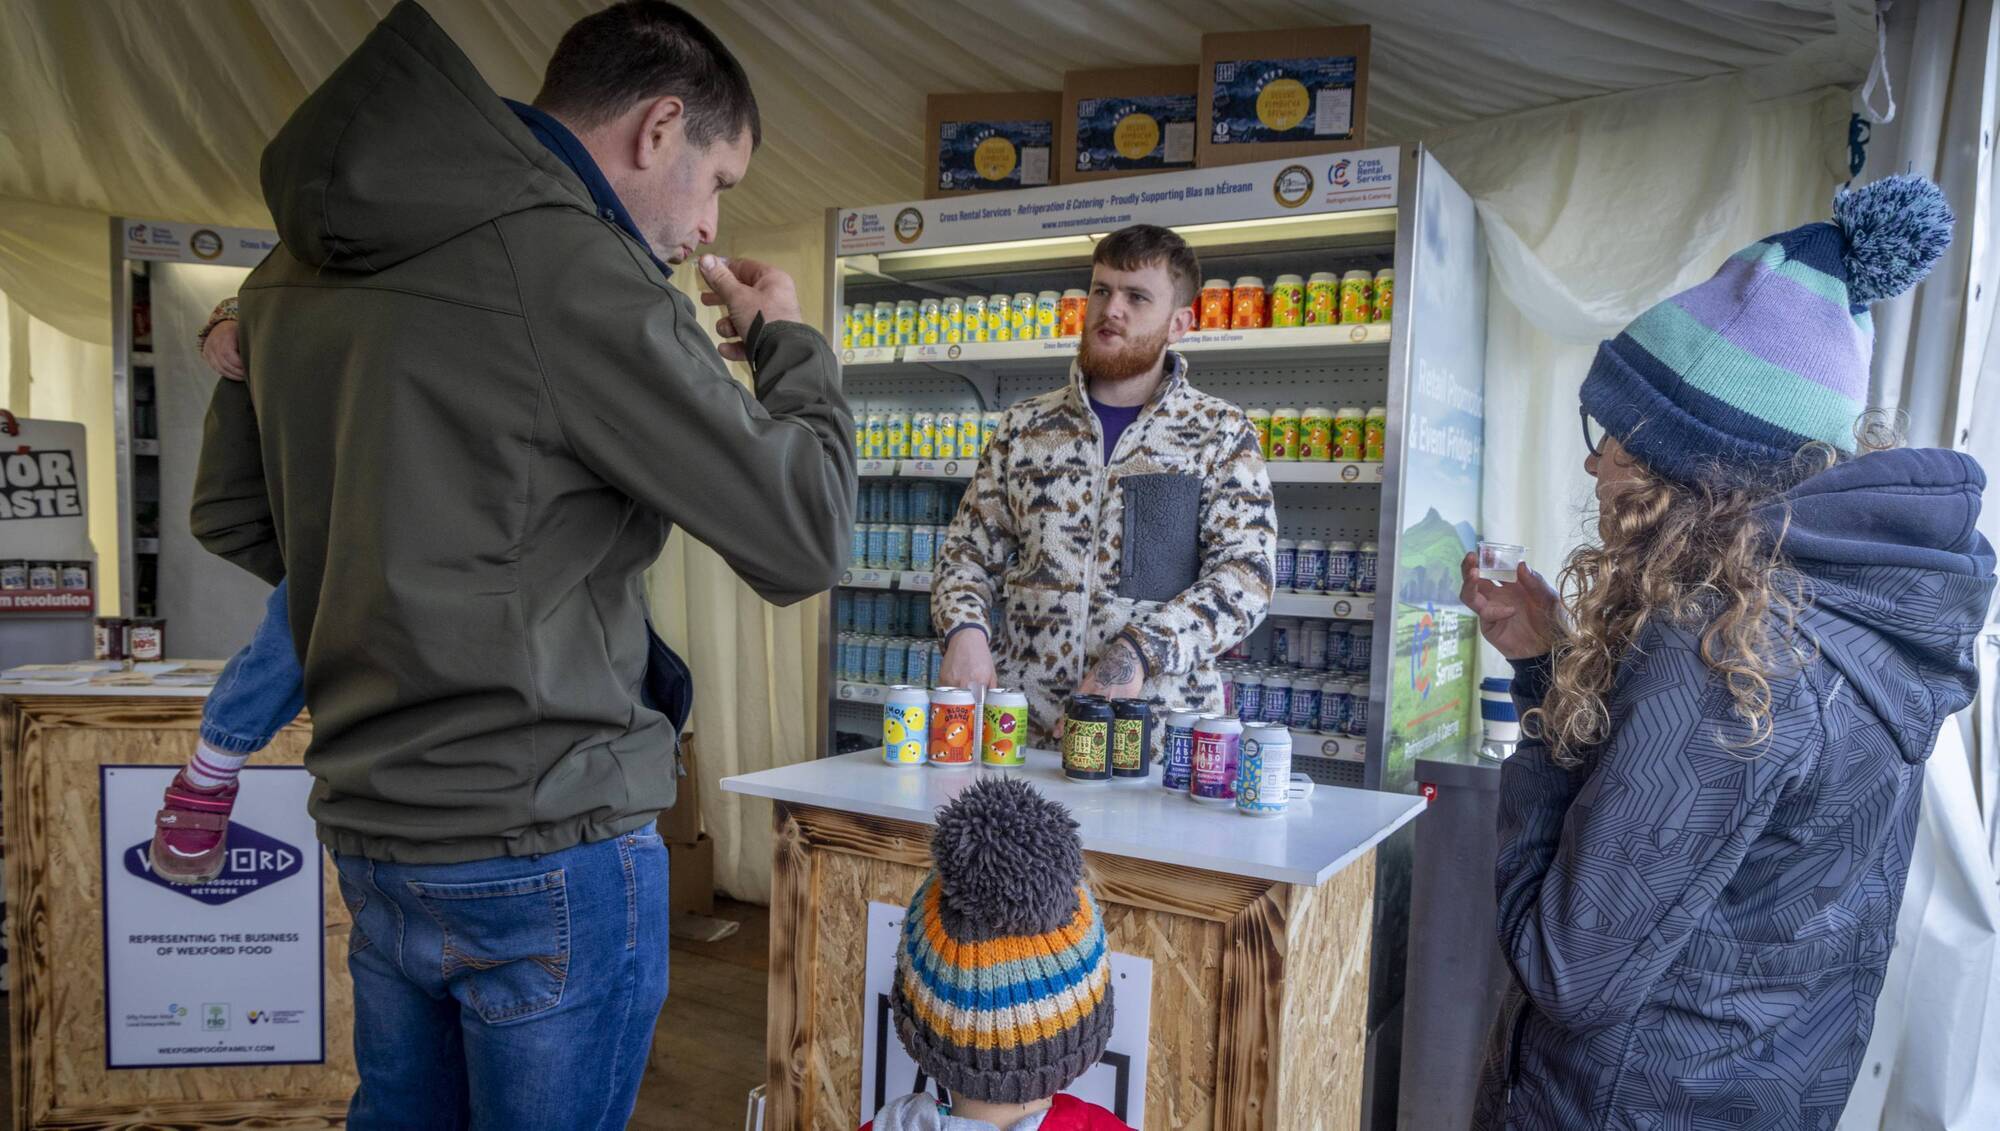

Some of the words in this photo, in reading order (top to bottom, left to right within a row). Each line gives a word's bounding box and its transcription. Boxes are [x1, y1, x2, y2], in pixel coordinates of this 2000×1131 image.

[1357, 159, 1381, 169] Cross
[1356, 166, 1384, 176] Rental
[1356, 174, 1392, 184] Services
[939, 212, 958, 223] Cross
[959, 209, 981, 221] Rental
[981, 207, 1012, 219] Services
[1017, 201, 1066, 216] Refrigeration
[1065, 199, 1073, 211] &
[1072, 197, 1105, 211] Catering
[1110, 192, 1139, 206] Proudly
[1140, 187, 1185, 204] Supporting
[1185, 186, 1203, 198] Blas
[1204, 187, 1215, 196] na
[1216, 180, 1253, 195] hÉireann
[1418, 357, 1448, 404] Retail
[1418, 416, 1446, 457] Event
[14, 594, 91, 607] revolution
[1201, 742, 1221, 754] ALL
[201, 879, 259, 887] RODUCERS
[190, 887, 238, 895] NETWORK
[128, 934, 217, 944] REPRESENTING
[219, 934, 242, 943] THE
[244, 932, 300, 943] BUSINESS
[156, 946, 174, 956] OF
[176, 946, 236, 956] WEXFORD
[237, 945, 273, 955] FOOD
[157, 1045, 275, 1055] WEXFORDFOODFAMILY.COM
